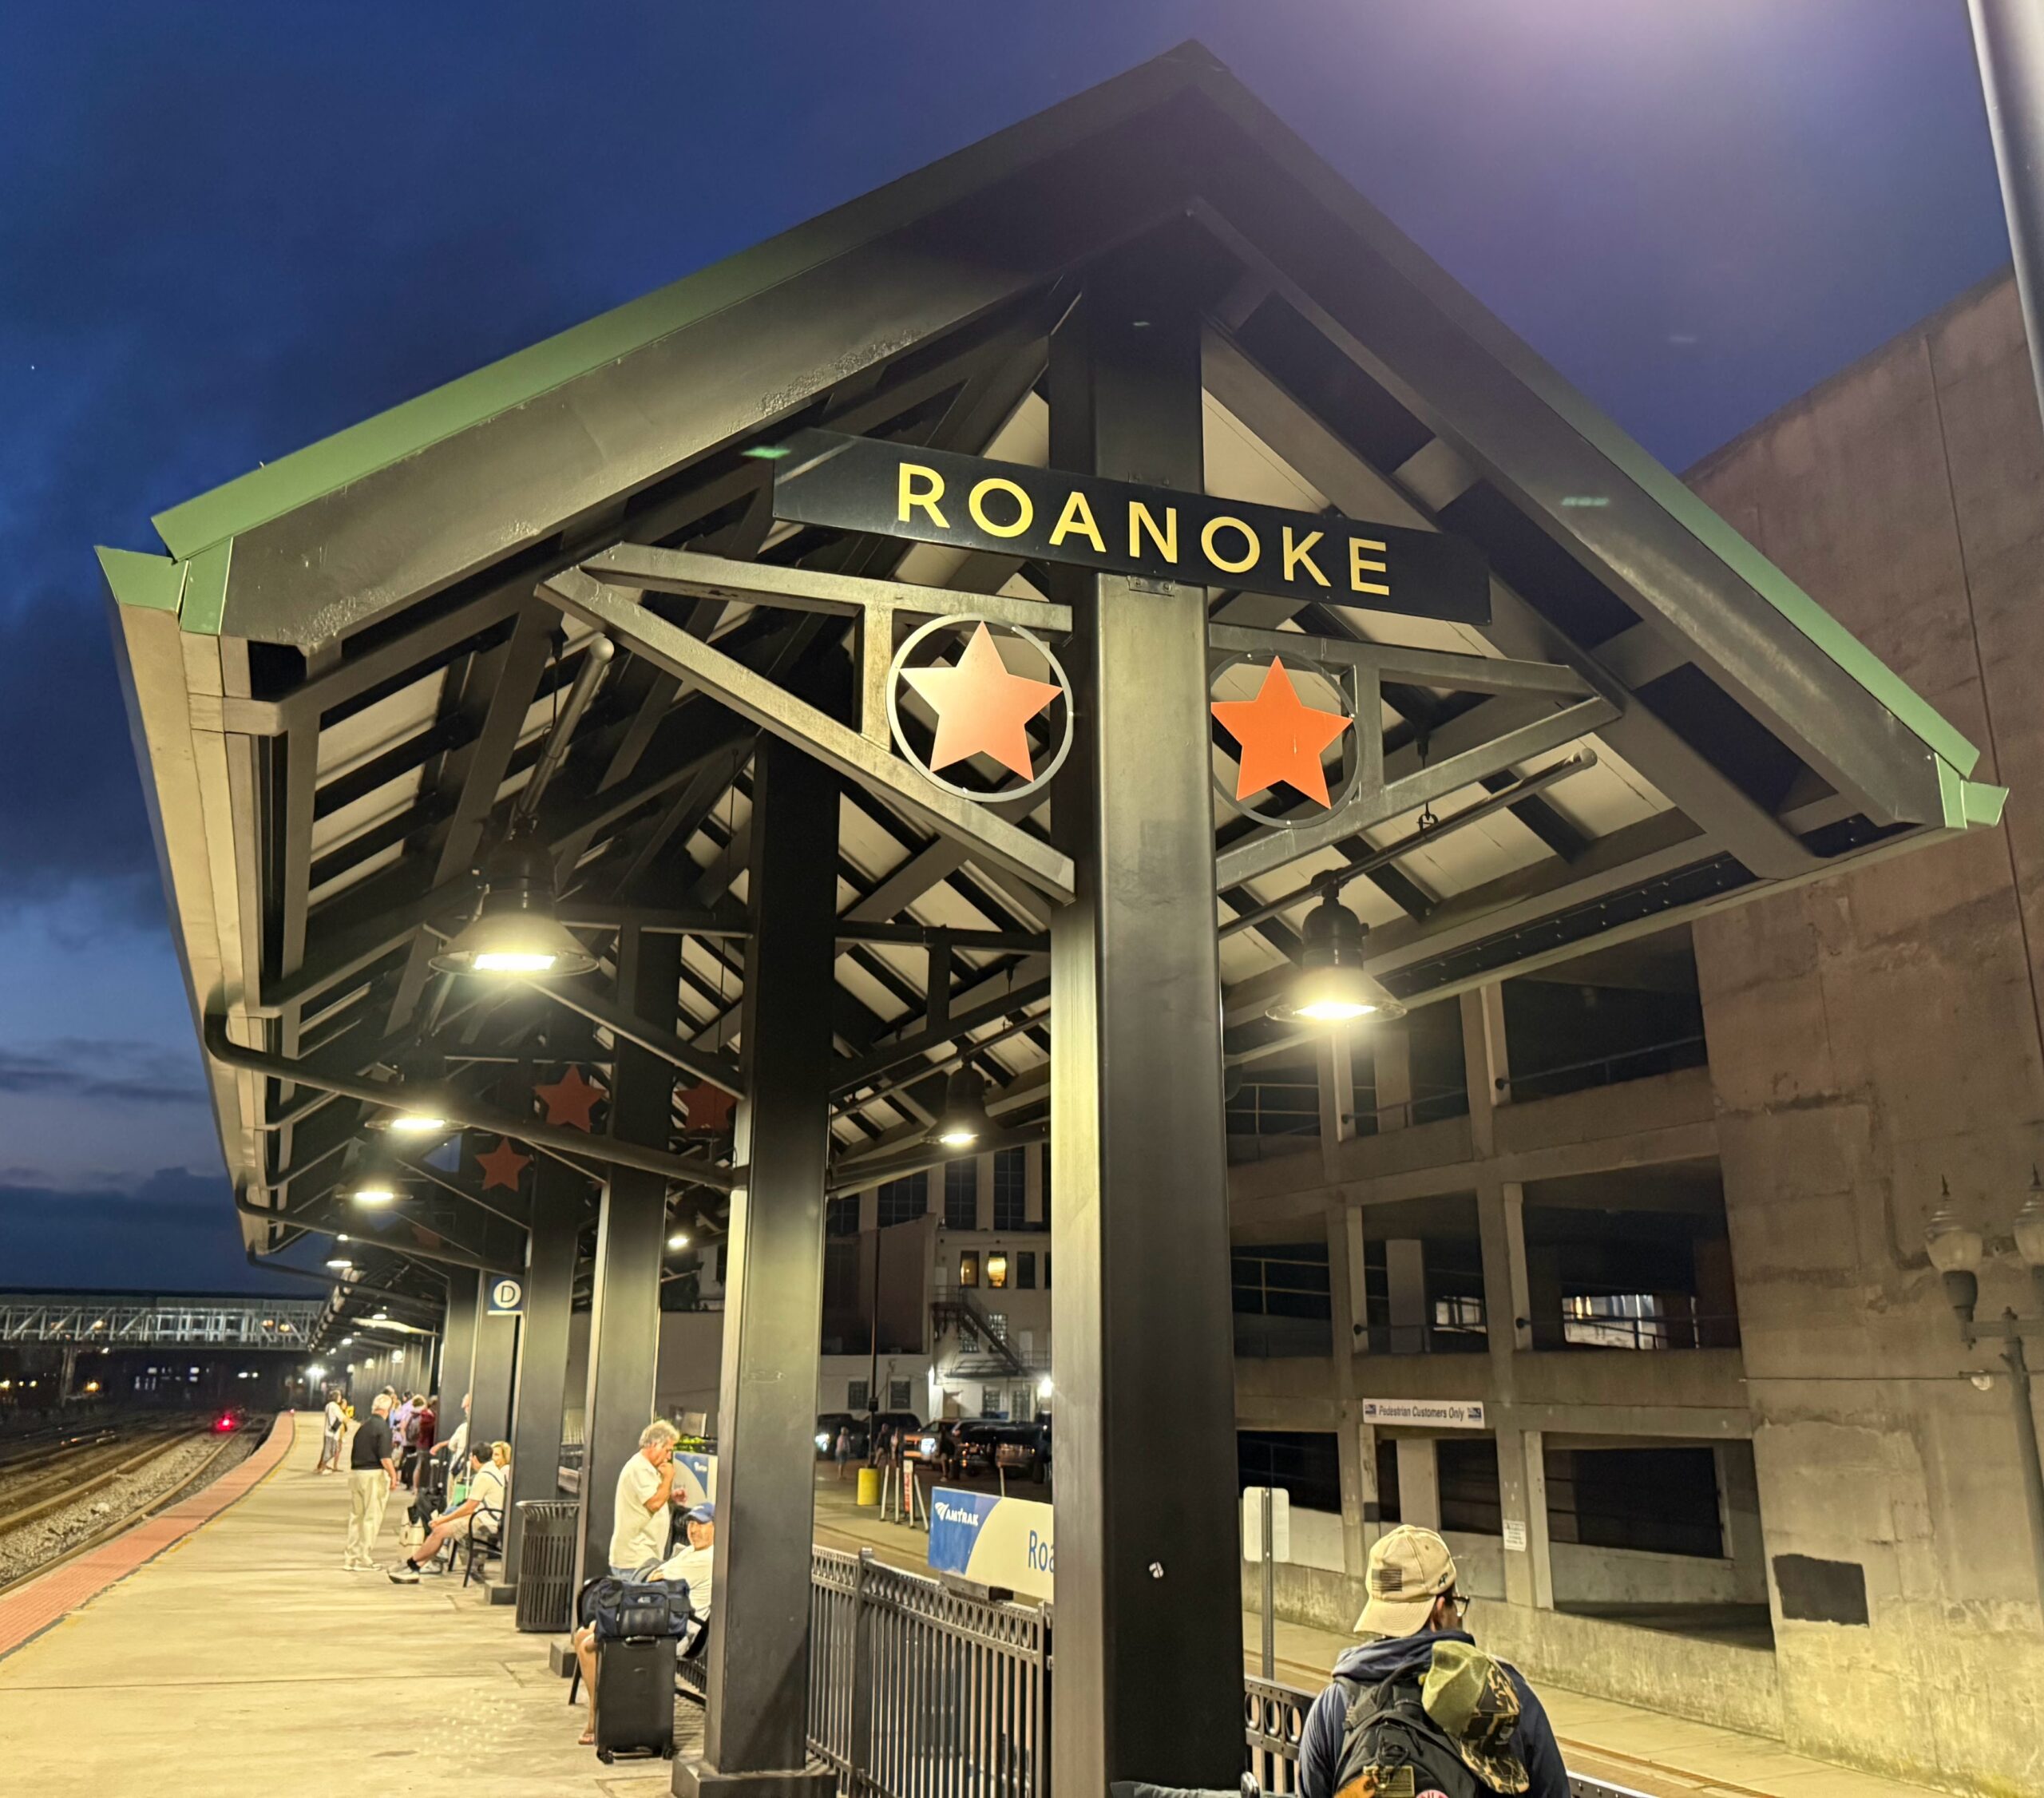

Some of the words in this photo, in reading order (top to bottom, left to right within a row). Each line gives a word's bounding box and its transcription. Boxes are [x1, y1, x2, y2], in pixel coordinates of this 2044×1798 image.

[897, 462, 1390, 596] ROANOKE
[501, 1285, 516, 1303] D
[1379, 1405, 1411, 1417] Pedestrian
[1412, 1406, 1448, 1419] Customers
[1448, 1408, 1465, 1421] Only
[945, 1507, 979, 1527] AMTRAK
